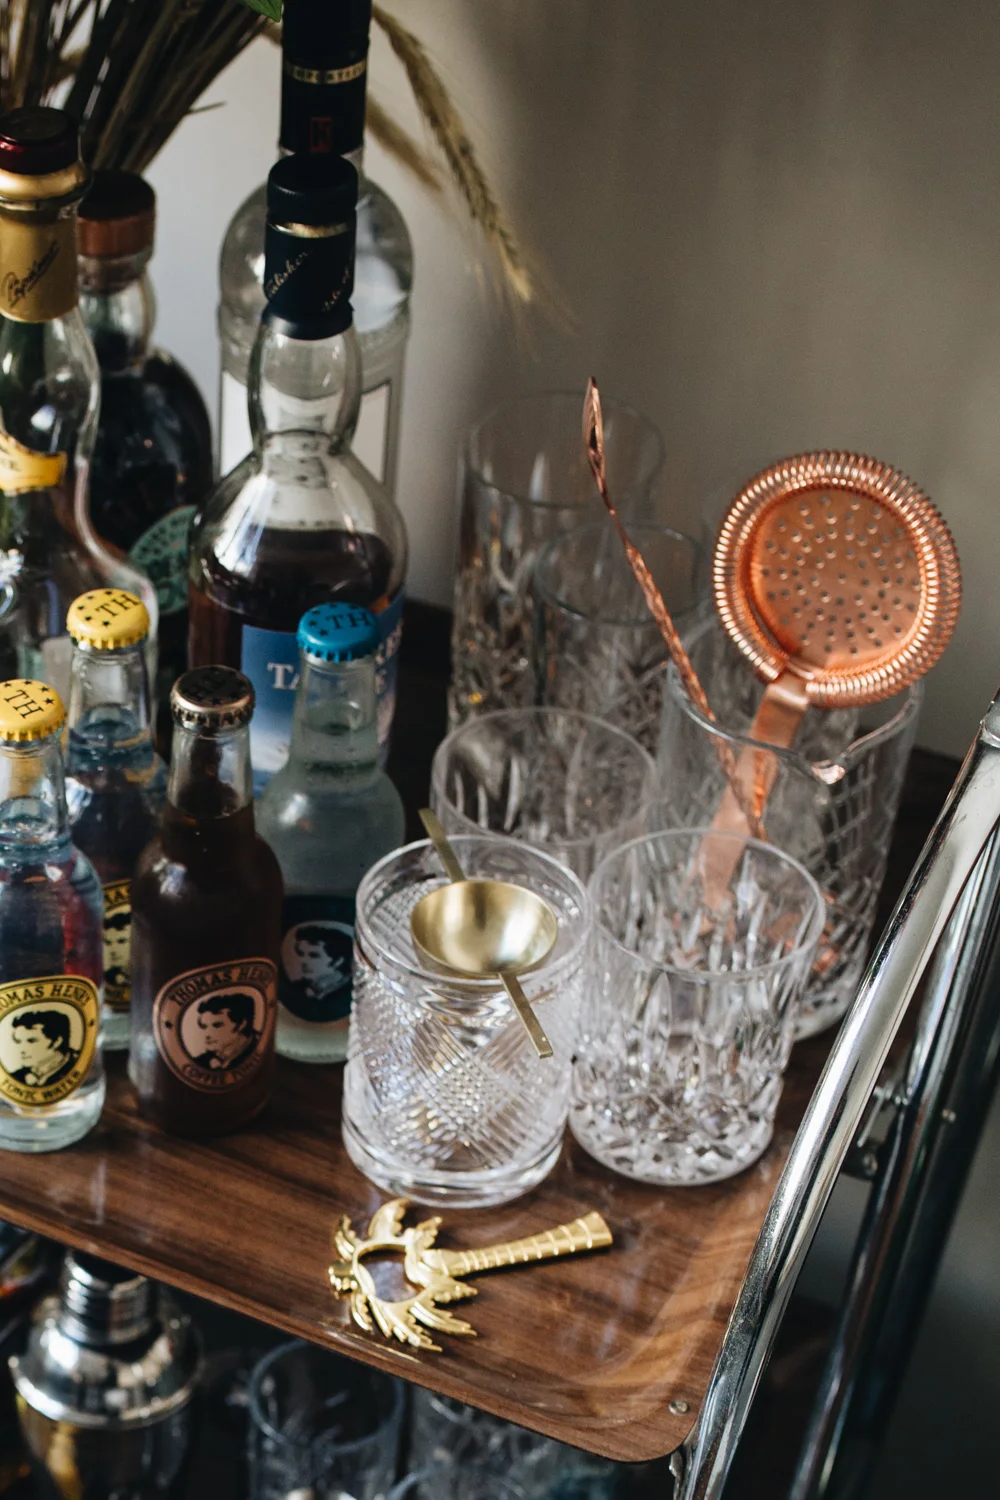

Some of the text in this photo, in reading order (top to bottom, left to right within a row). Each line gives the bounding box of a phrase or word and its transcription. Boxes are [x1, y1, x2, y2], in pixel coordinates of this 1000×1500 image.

[95, 593, 142, 619] TH
[325, 611, 373, 631] TH
[3, 689, 43, 720] TH
[168, 969, 233, 1006] THOMAS
[1, 1079, 36, 1100] TONIC
